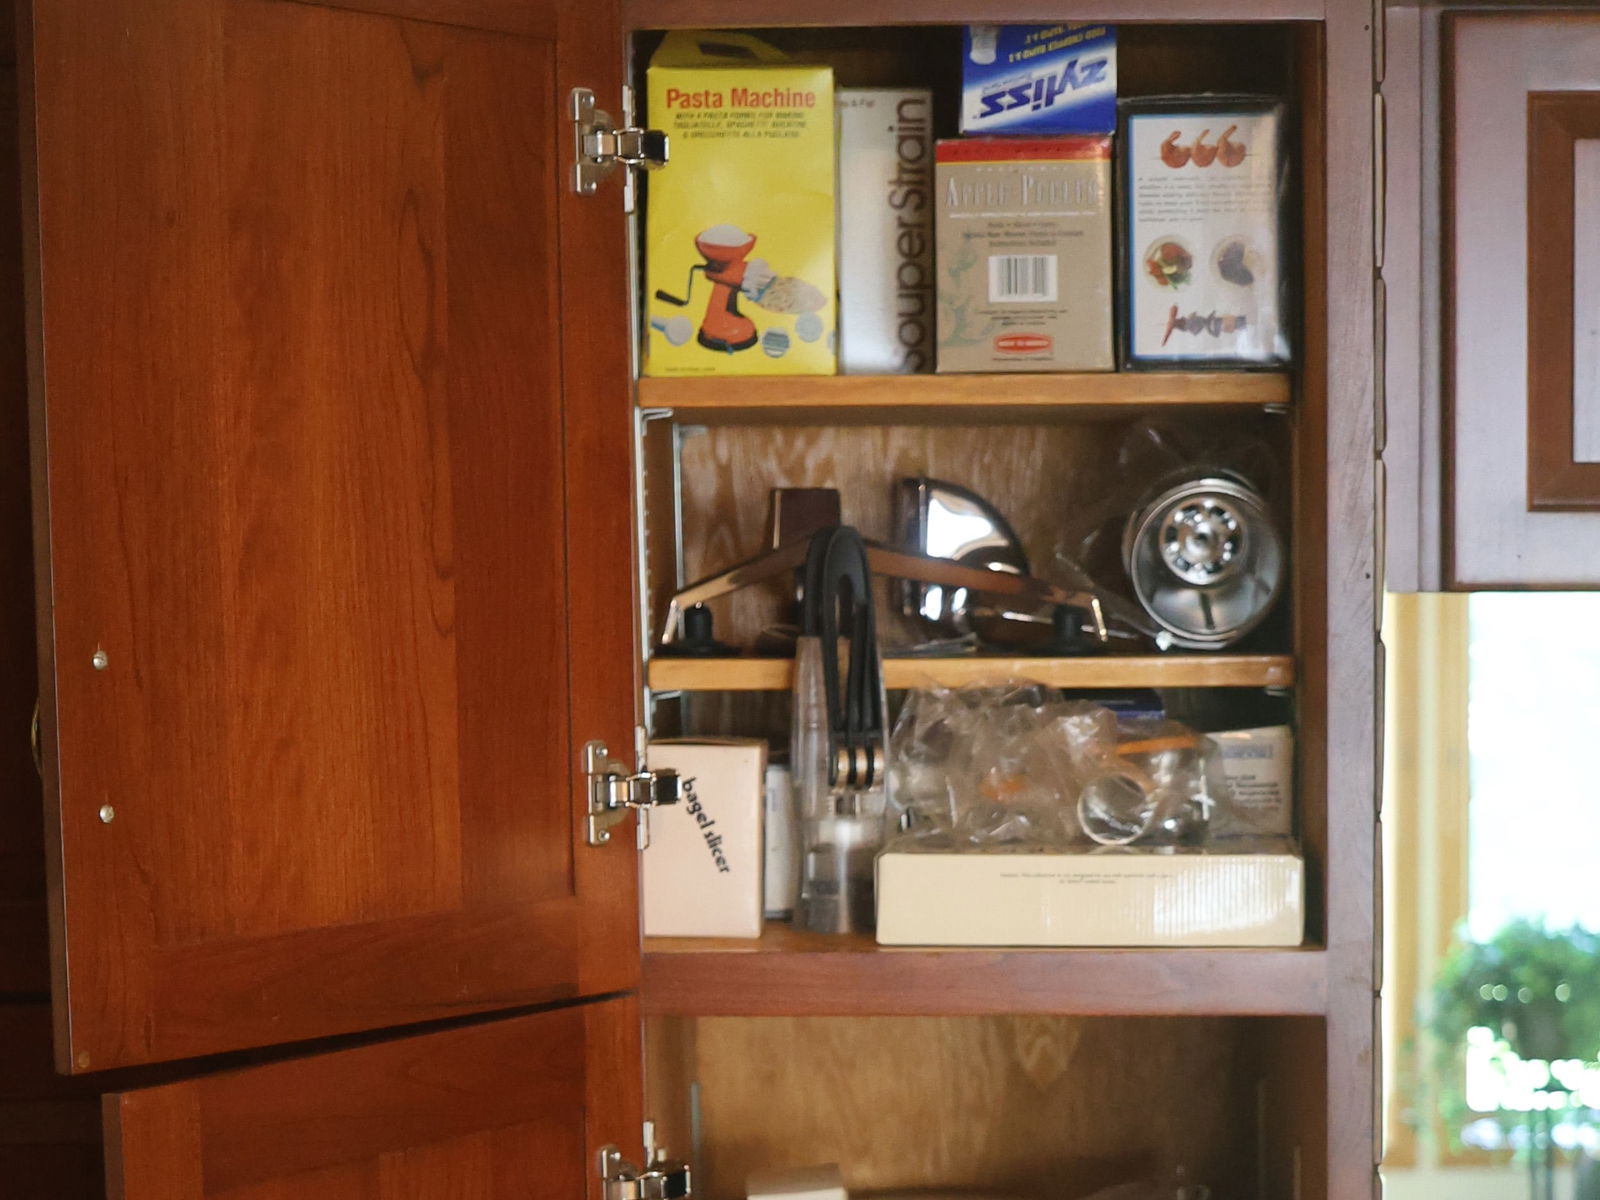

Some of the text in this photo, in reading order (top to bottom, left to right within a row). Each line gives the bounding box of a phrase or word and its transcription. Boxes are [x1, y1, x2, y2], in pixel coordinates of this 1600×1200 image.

[666, 88, 723, 109] Pasta
[730, 87, 816, 109] Machine
[979, 58, 1108, 120] zyliss
[682, 776, 730, 873] bagel slicer
